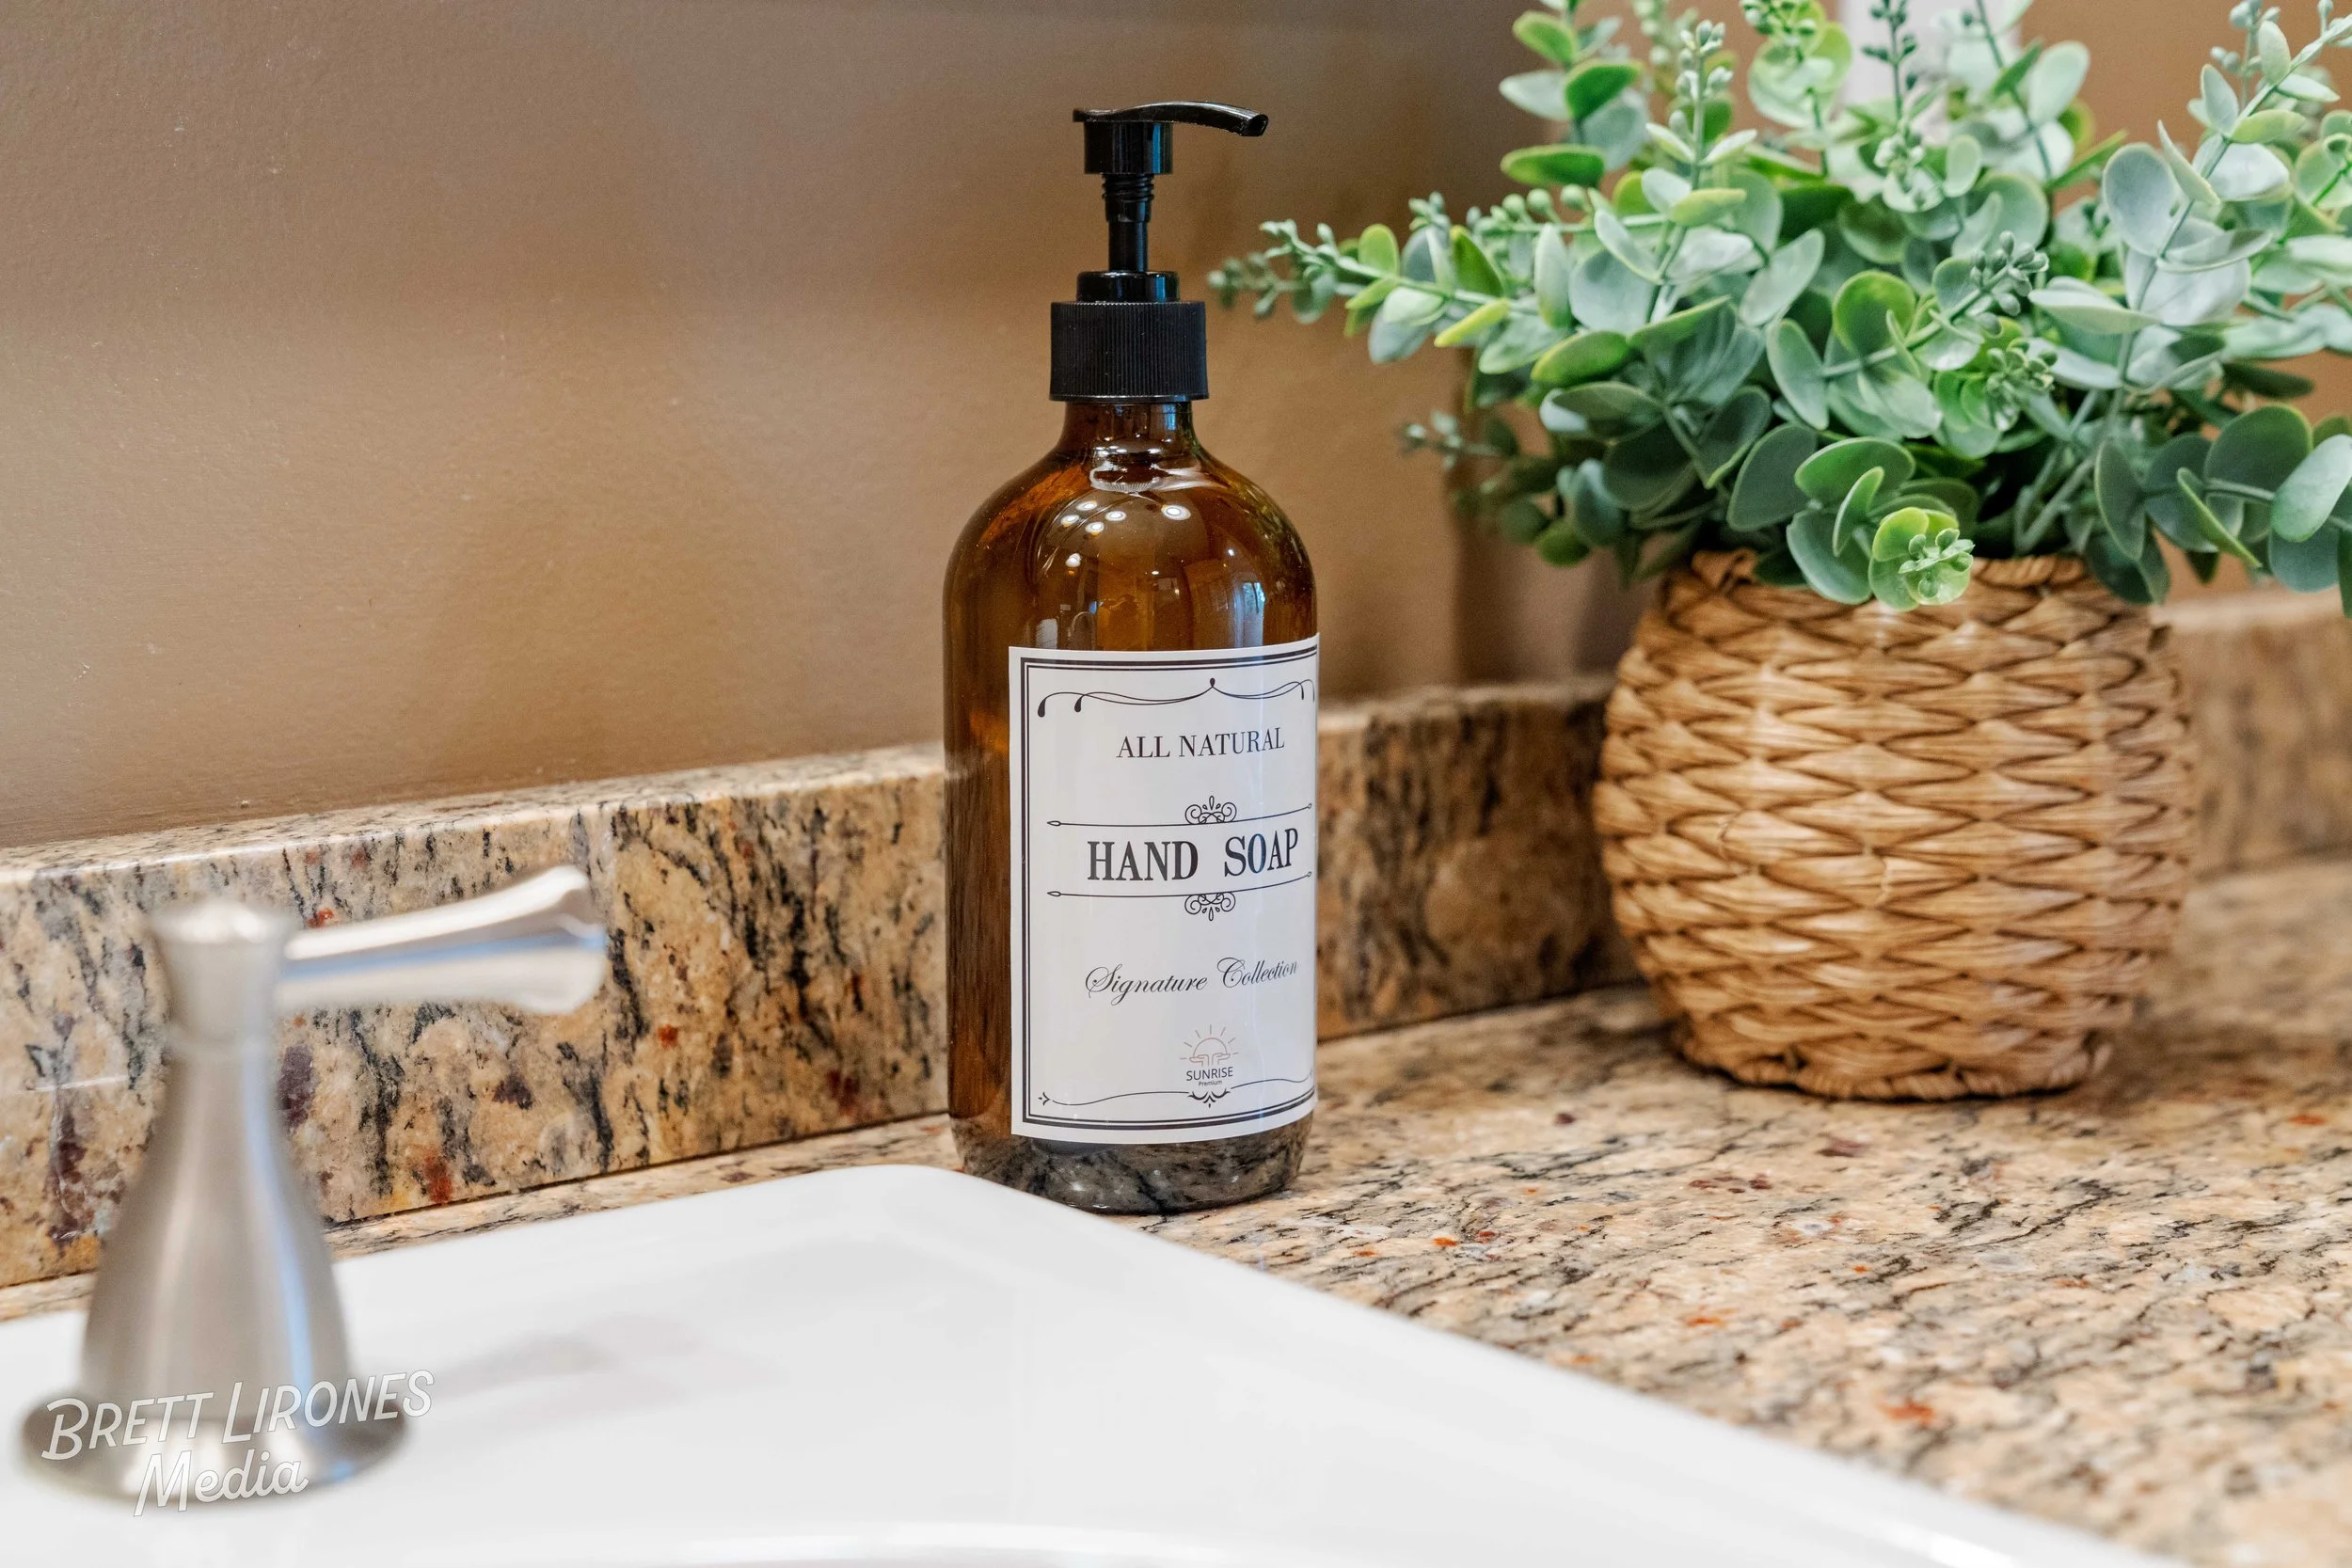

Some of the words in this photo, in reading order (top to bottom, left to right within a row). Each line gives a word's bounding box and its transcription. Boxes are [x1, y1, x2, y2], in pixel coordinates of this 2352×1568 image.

[1116, 736, 1170, 758] ALL
[1178, 727, 1285, 757] NATURAL
[1087, 840, 1199, 881] HAND
[1224, 828, 1298, 877] SOAP
[1085, 963, 1208, 1006] Signature
[1216, 957, 1297, 989] Collection
[1186, 1066, 1233, 1081] SUNRISE
